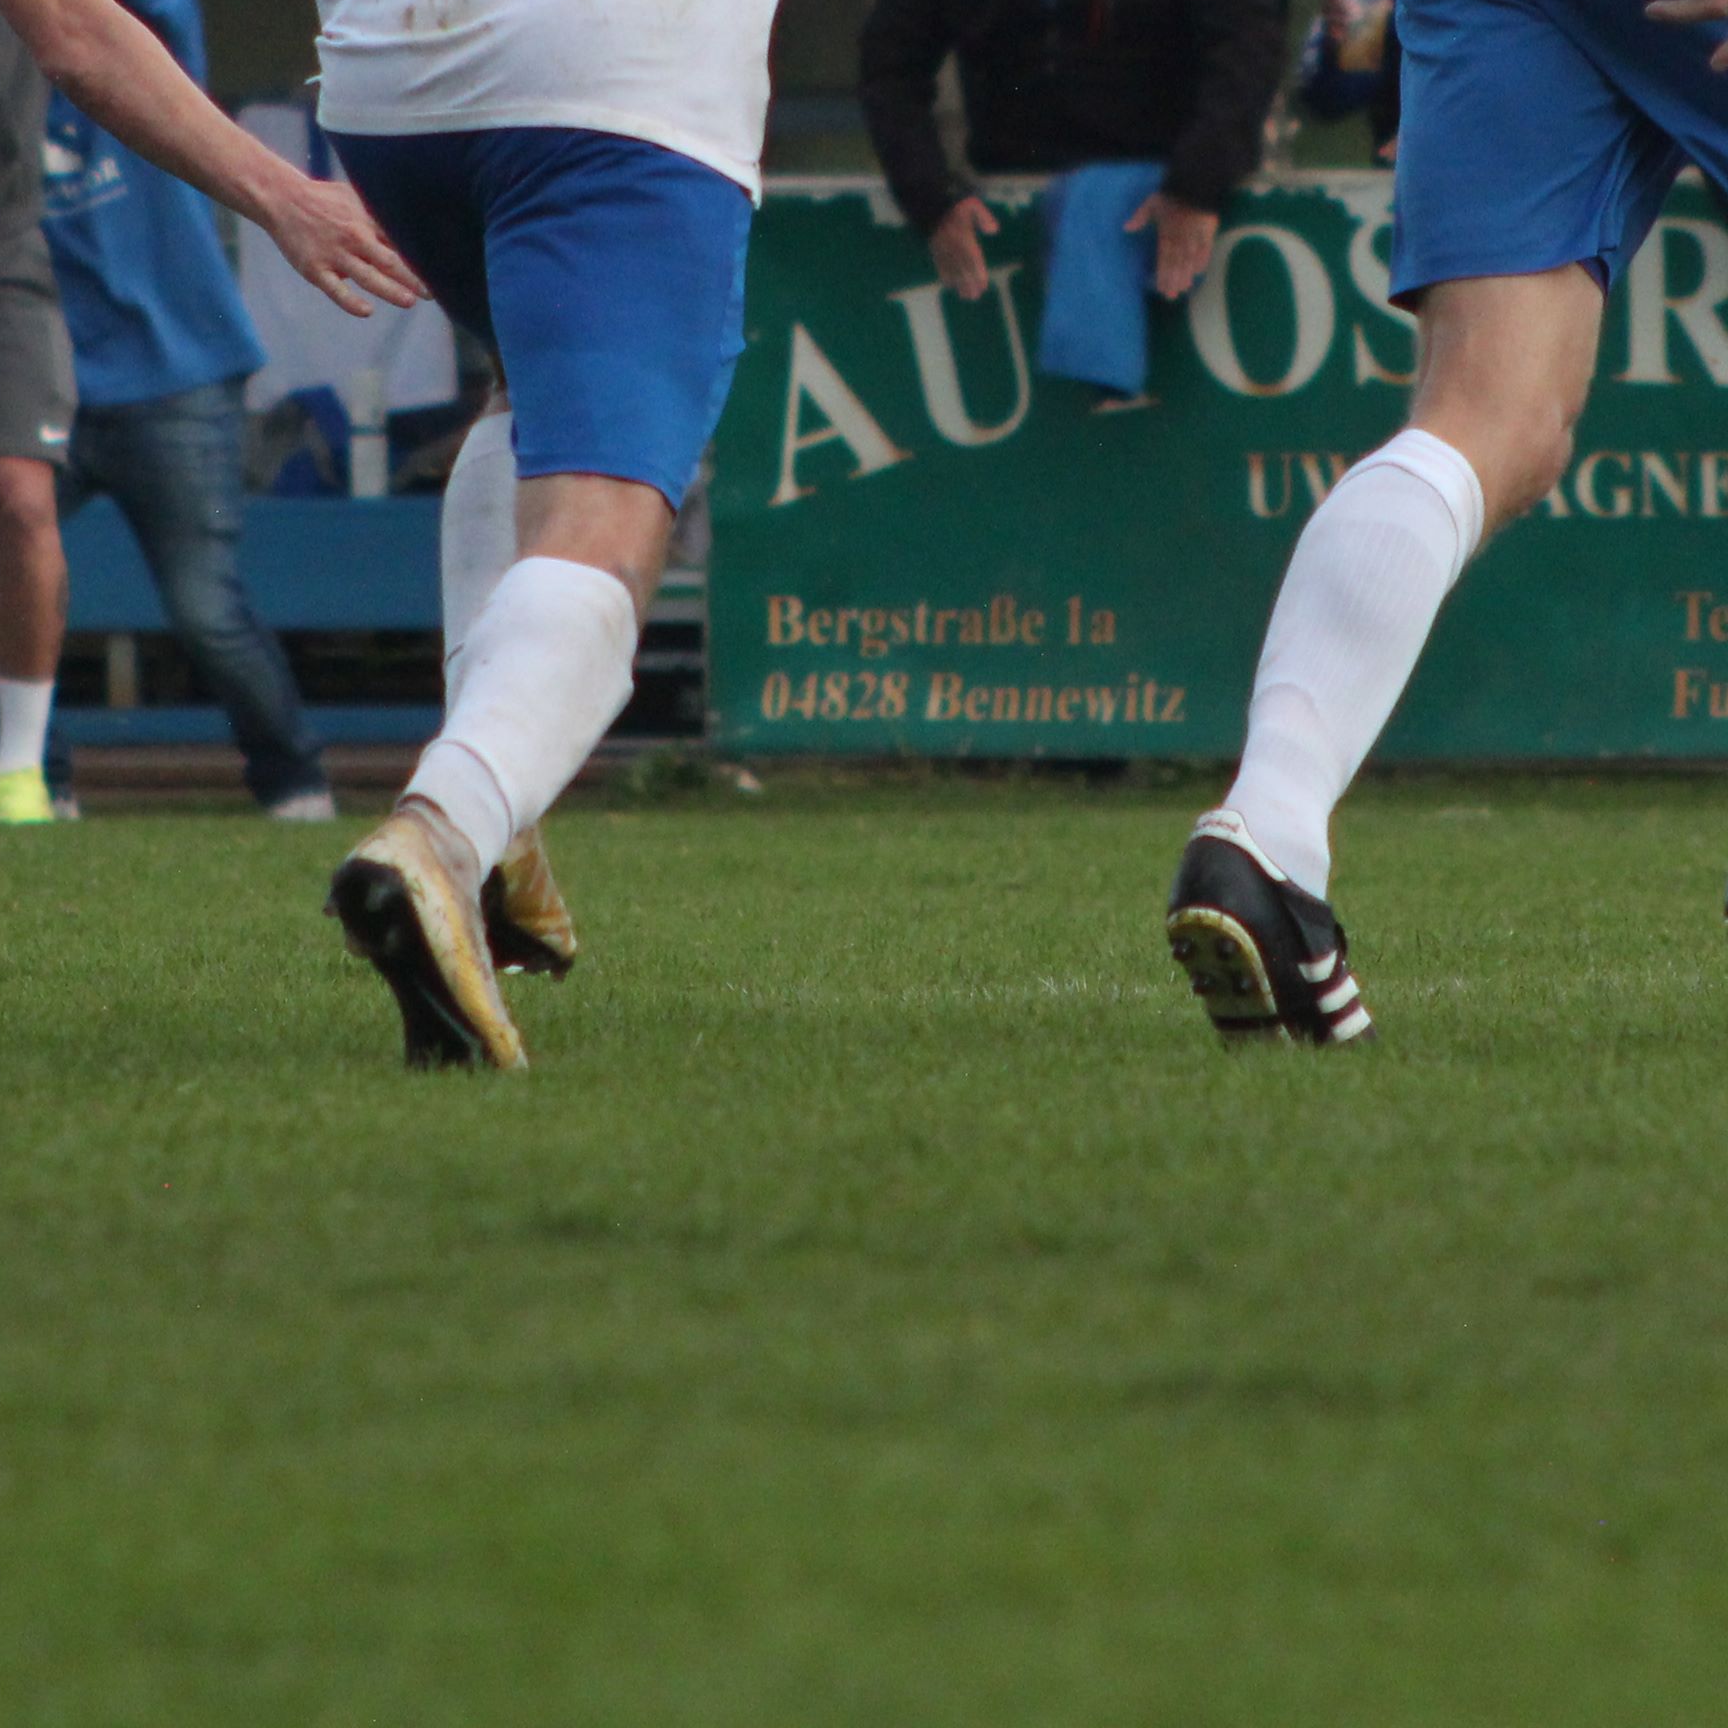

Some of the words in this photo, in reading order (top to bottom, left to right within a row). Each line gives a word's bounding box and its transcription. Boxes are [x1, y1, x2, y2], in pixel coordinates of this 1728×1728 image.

[766, 593, 1046, 658] Bergstraße
[1065, 594, 1116, 646] 1a
[759, 670, 909, 721] 04828
[924, 670, 1187, 725] Bennewitz
